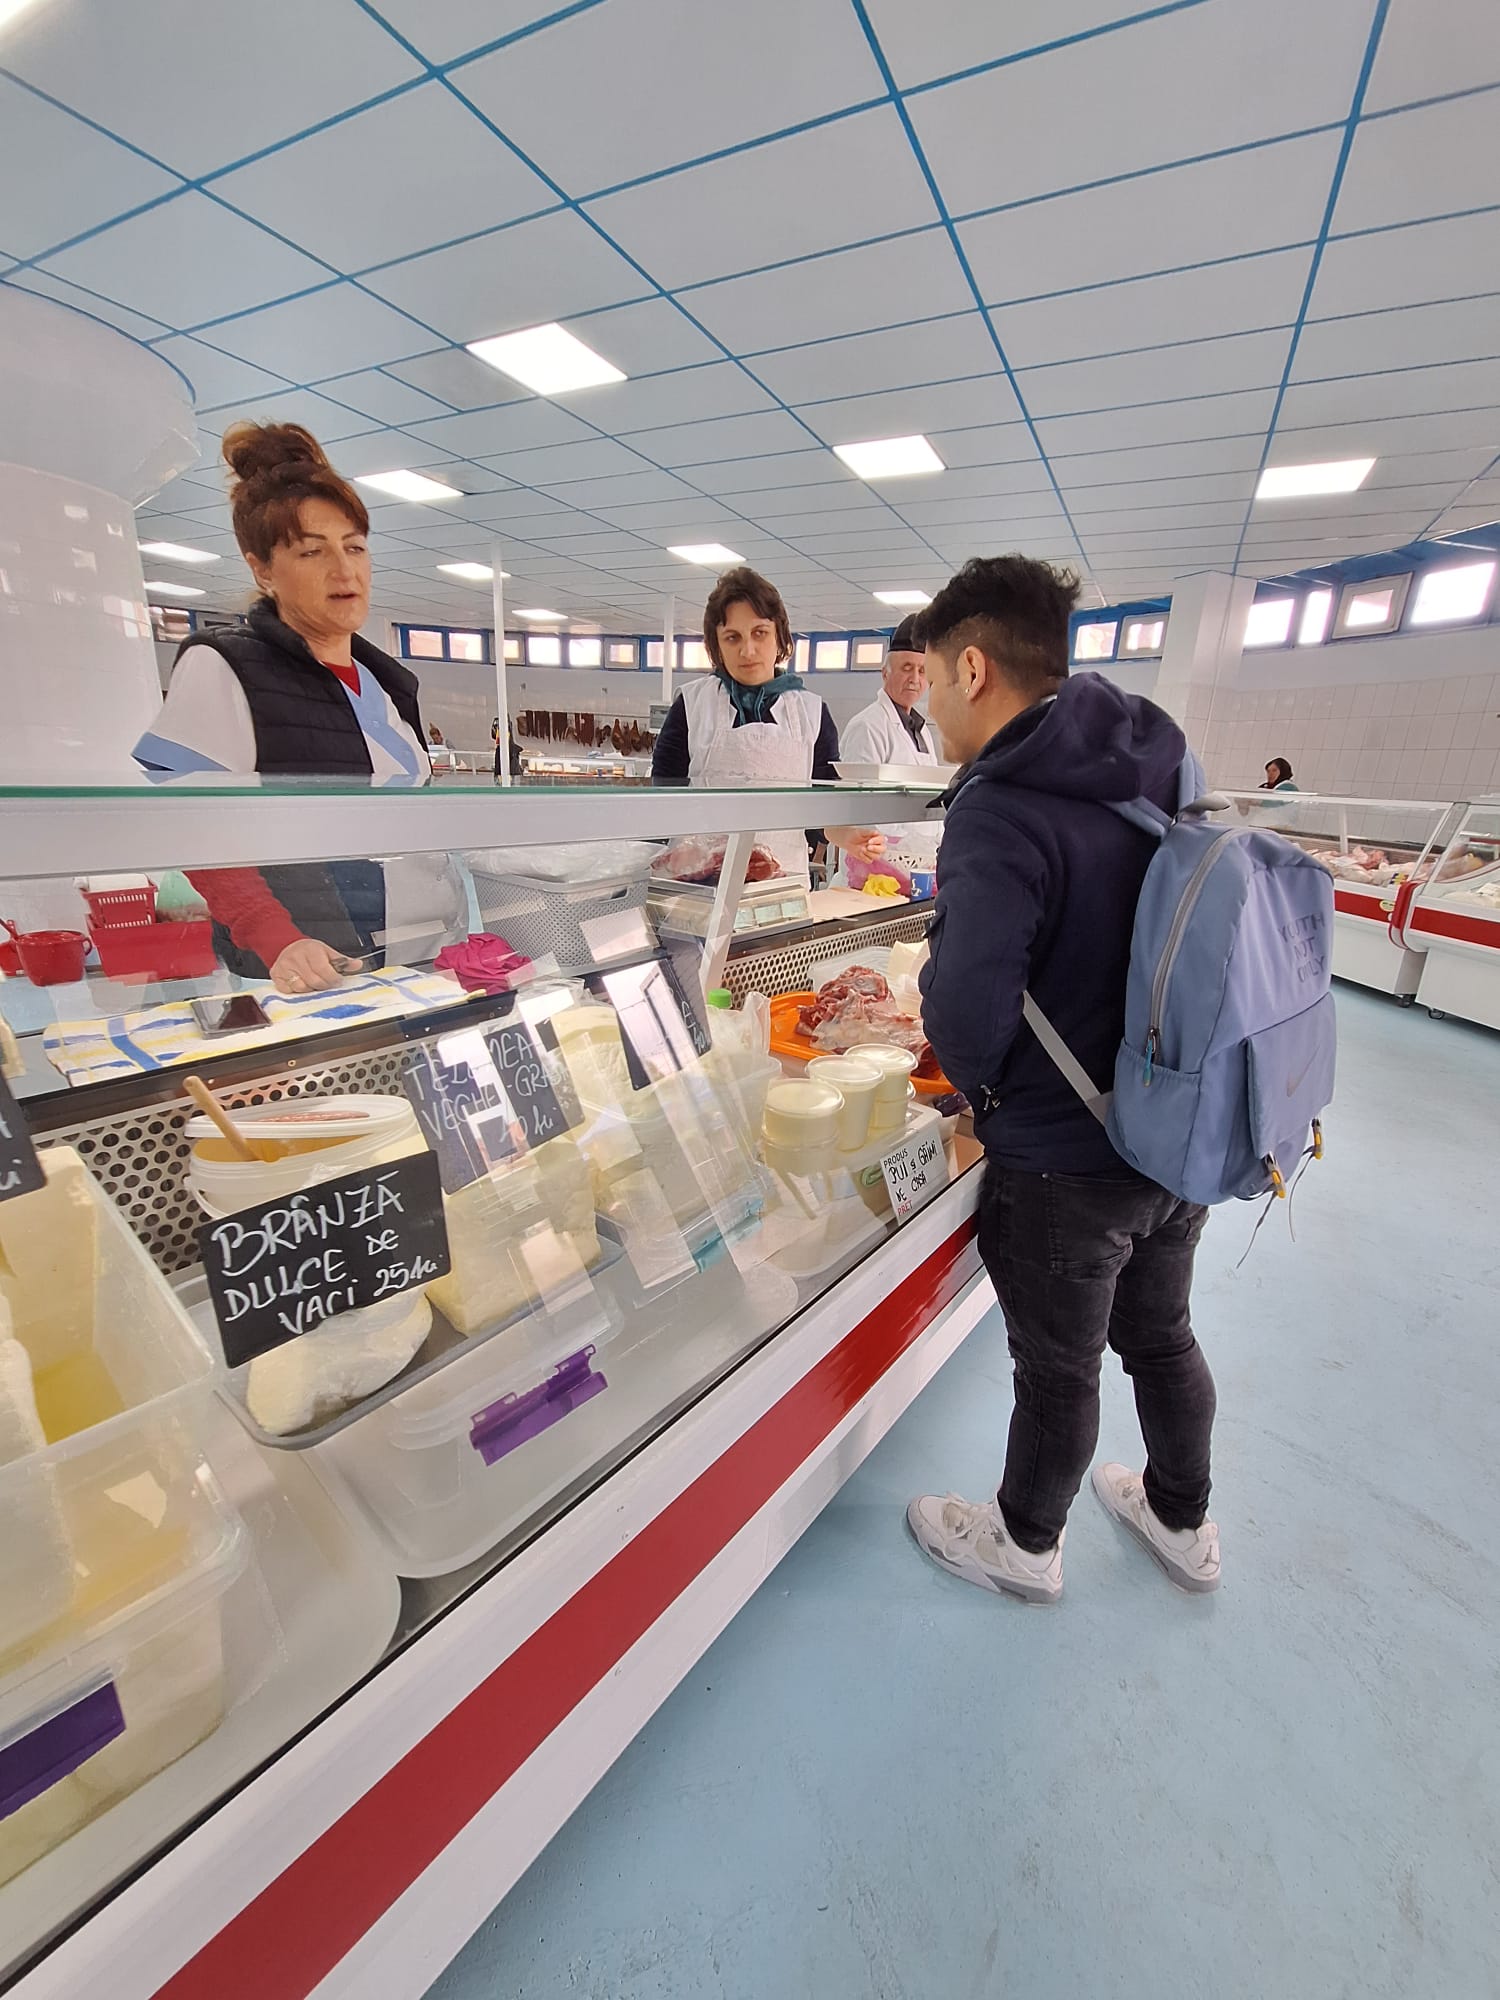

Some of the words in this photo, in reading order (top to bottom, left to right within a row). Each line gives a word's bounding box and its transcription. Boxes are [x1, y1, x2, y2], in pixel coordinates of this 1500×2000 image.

[1278, 911, 1326, 943] YOUTH
[883, 1148, 909, 1168] PRODUS
[889, 1161, 909, 1184] PUI
[223, 1249, 347, 1322] DULCE
[365, 1229, 399, 1256] DE
